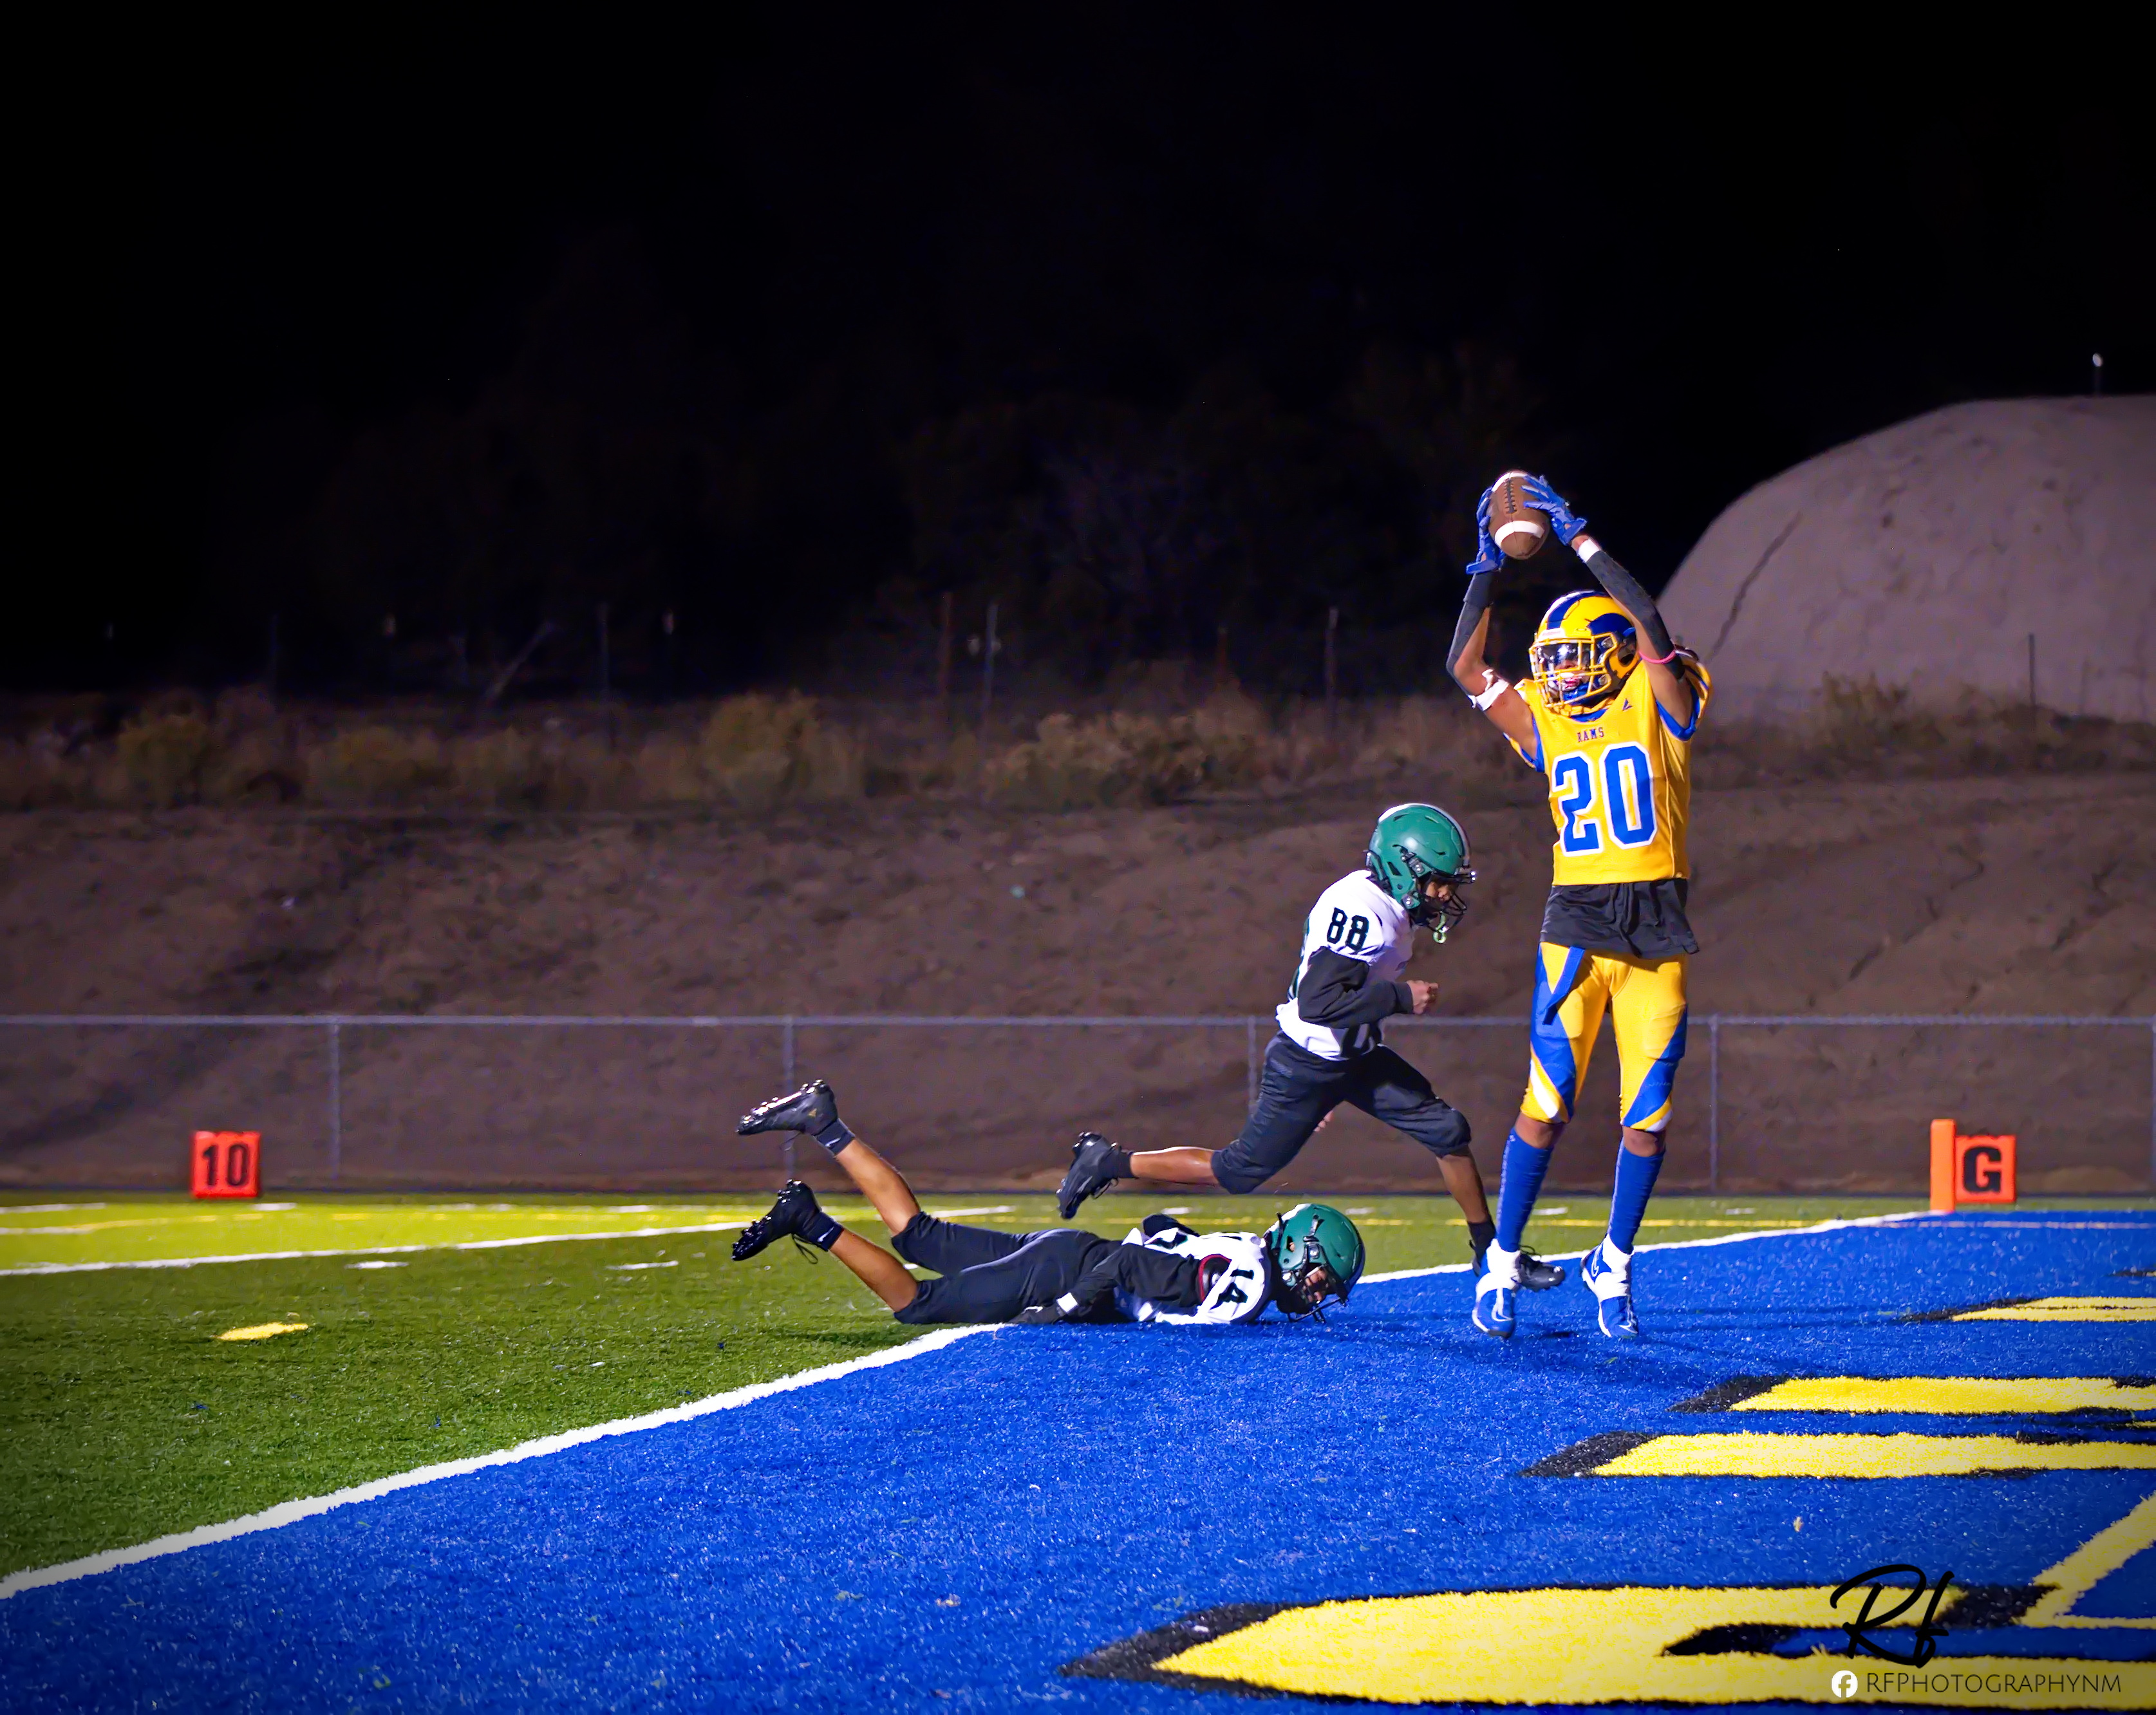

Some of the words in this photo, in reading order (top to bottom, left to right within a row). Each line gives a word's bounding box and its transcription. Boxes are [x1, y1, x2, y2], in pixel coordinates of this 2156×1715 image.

[1577, 727, 1604, 742] RAMS
[1551, 742, 1657, 857] 20
[1327, 907, 1369, 951] 88
[202, 1144, 250, 1186] 10
[1962, 1146, 2001, 1193] G
[1210, 1269, 1255, 1310] 14
